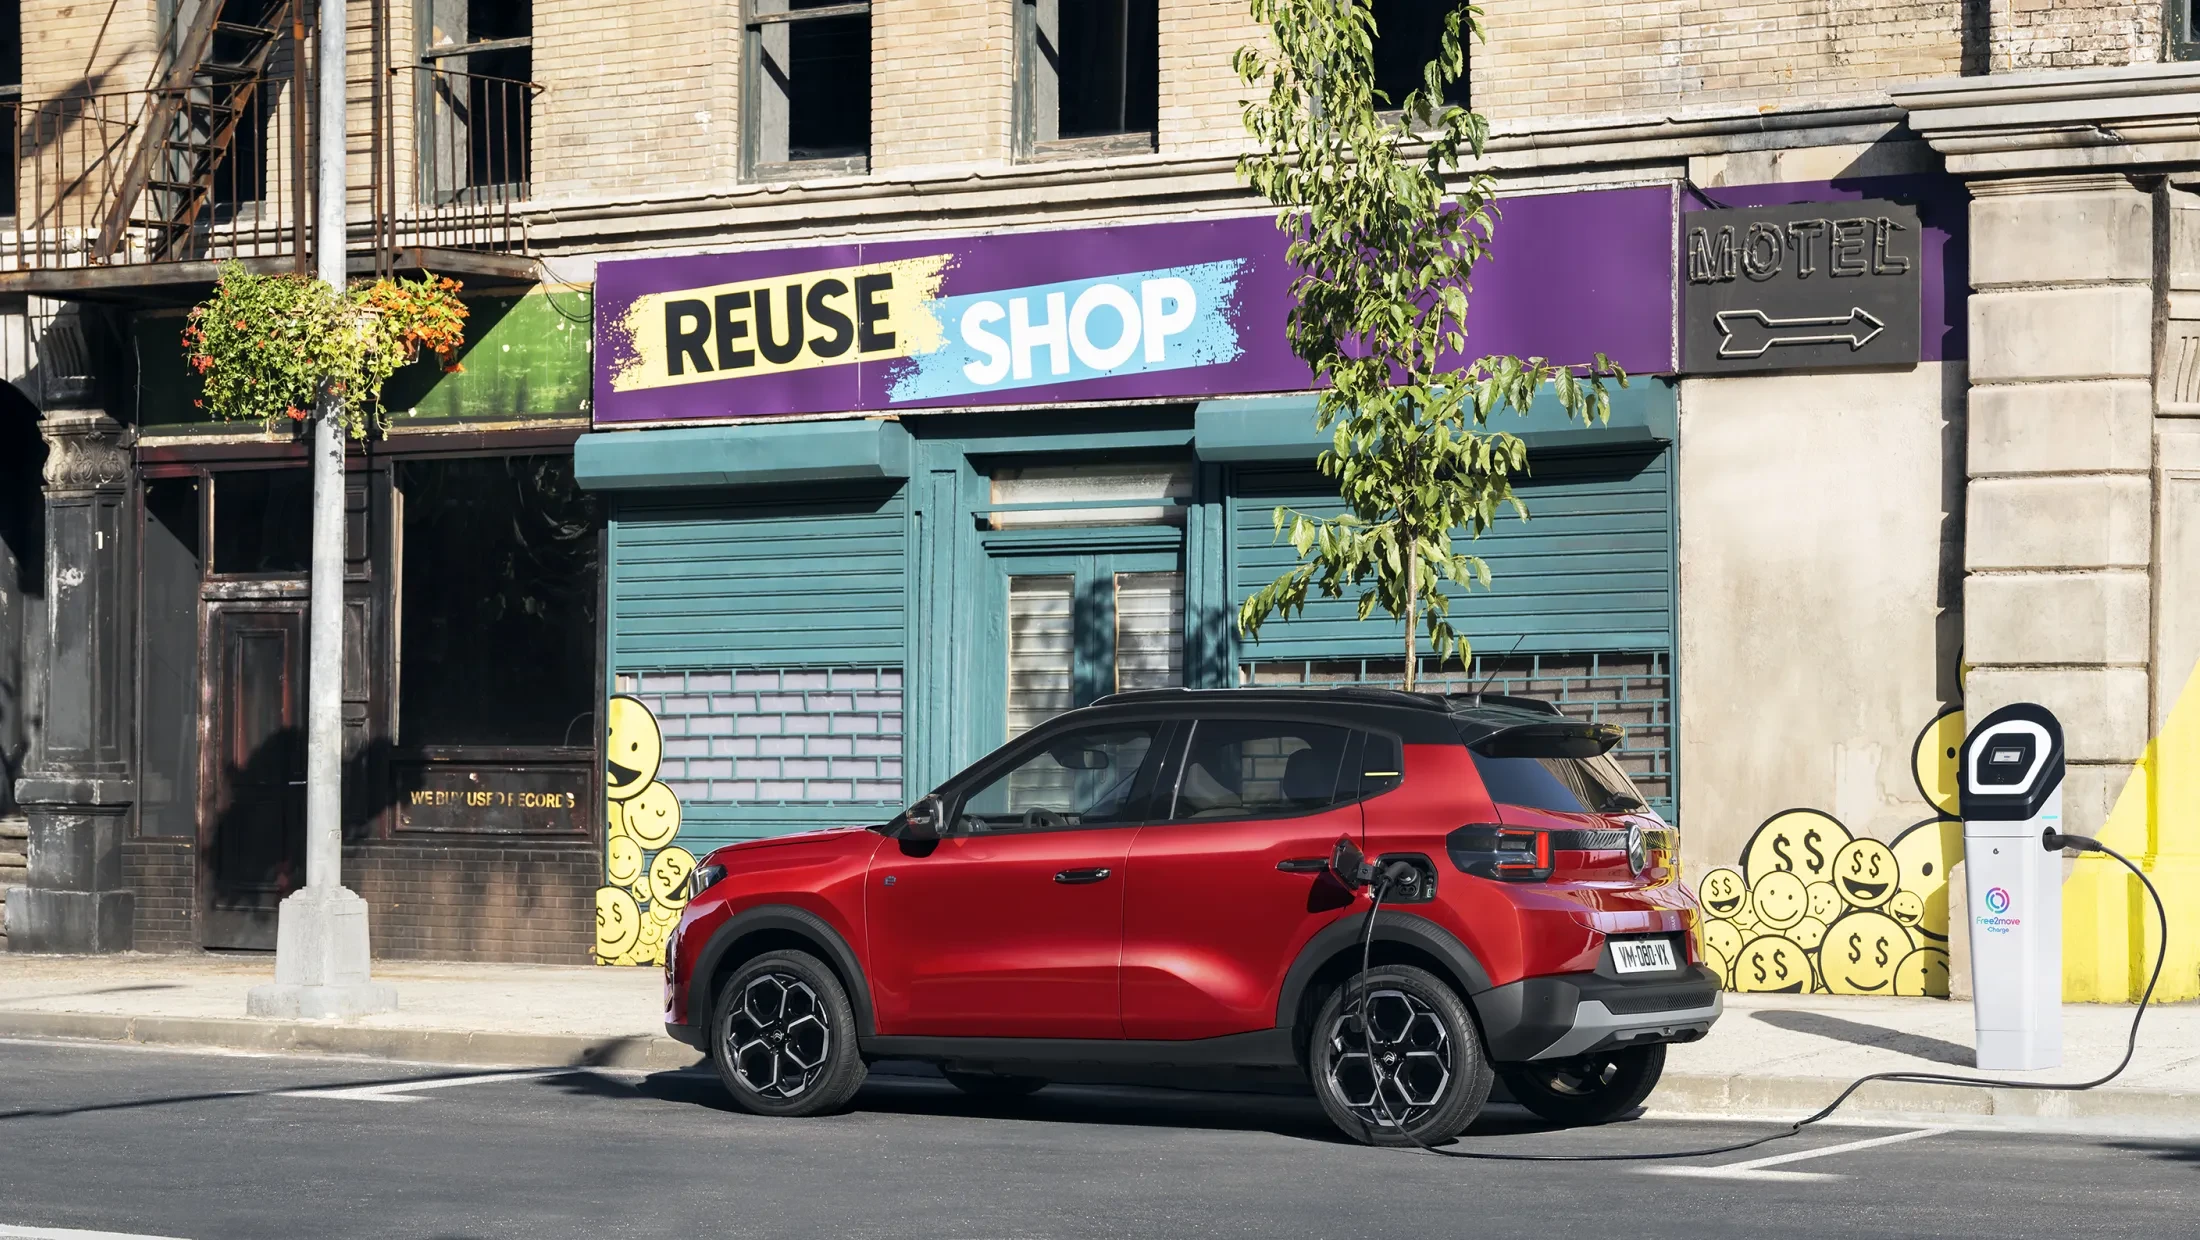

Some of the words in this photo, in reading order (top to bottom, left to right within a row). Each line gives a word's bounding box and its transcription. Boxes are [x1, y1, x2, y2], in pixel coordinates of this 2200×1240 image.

[1688, 217, 1910, 283] MOTEL
[664, 272, 896, 376] REUSE
[960, 276, 1196, 386] SHOP
[410, 791, 433, 806] WE
[436, 791, 464, 806] BUY
[1975, 916, 2021, 925] Free2move
[1618, 944, 1670, 969] VM-080-VX
